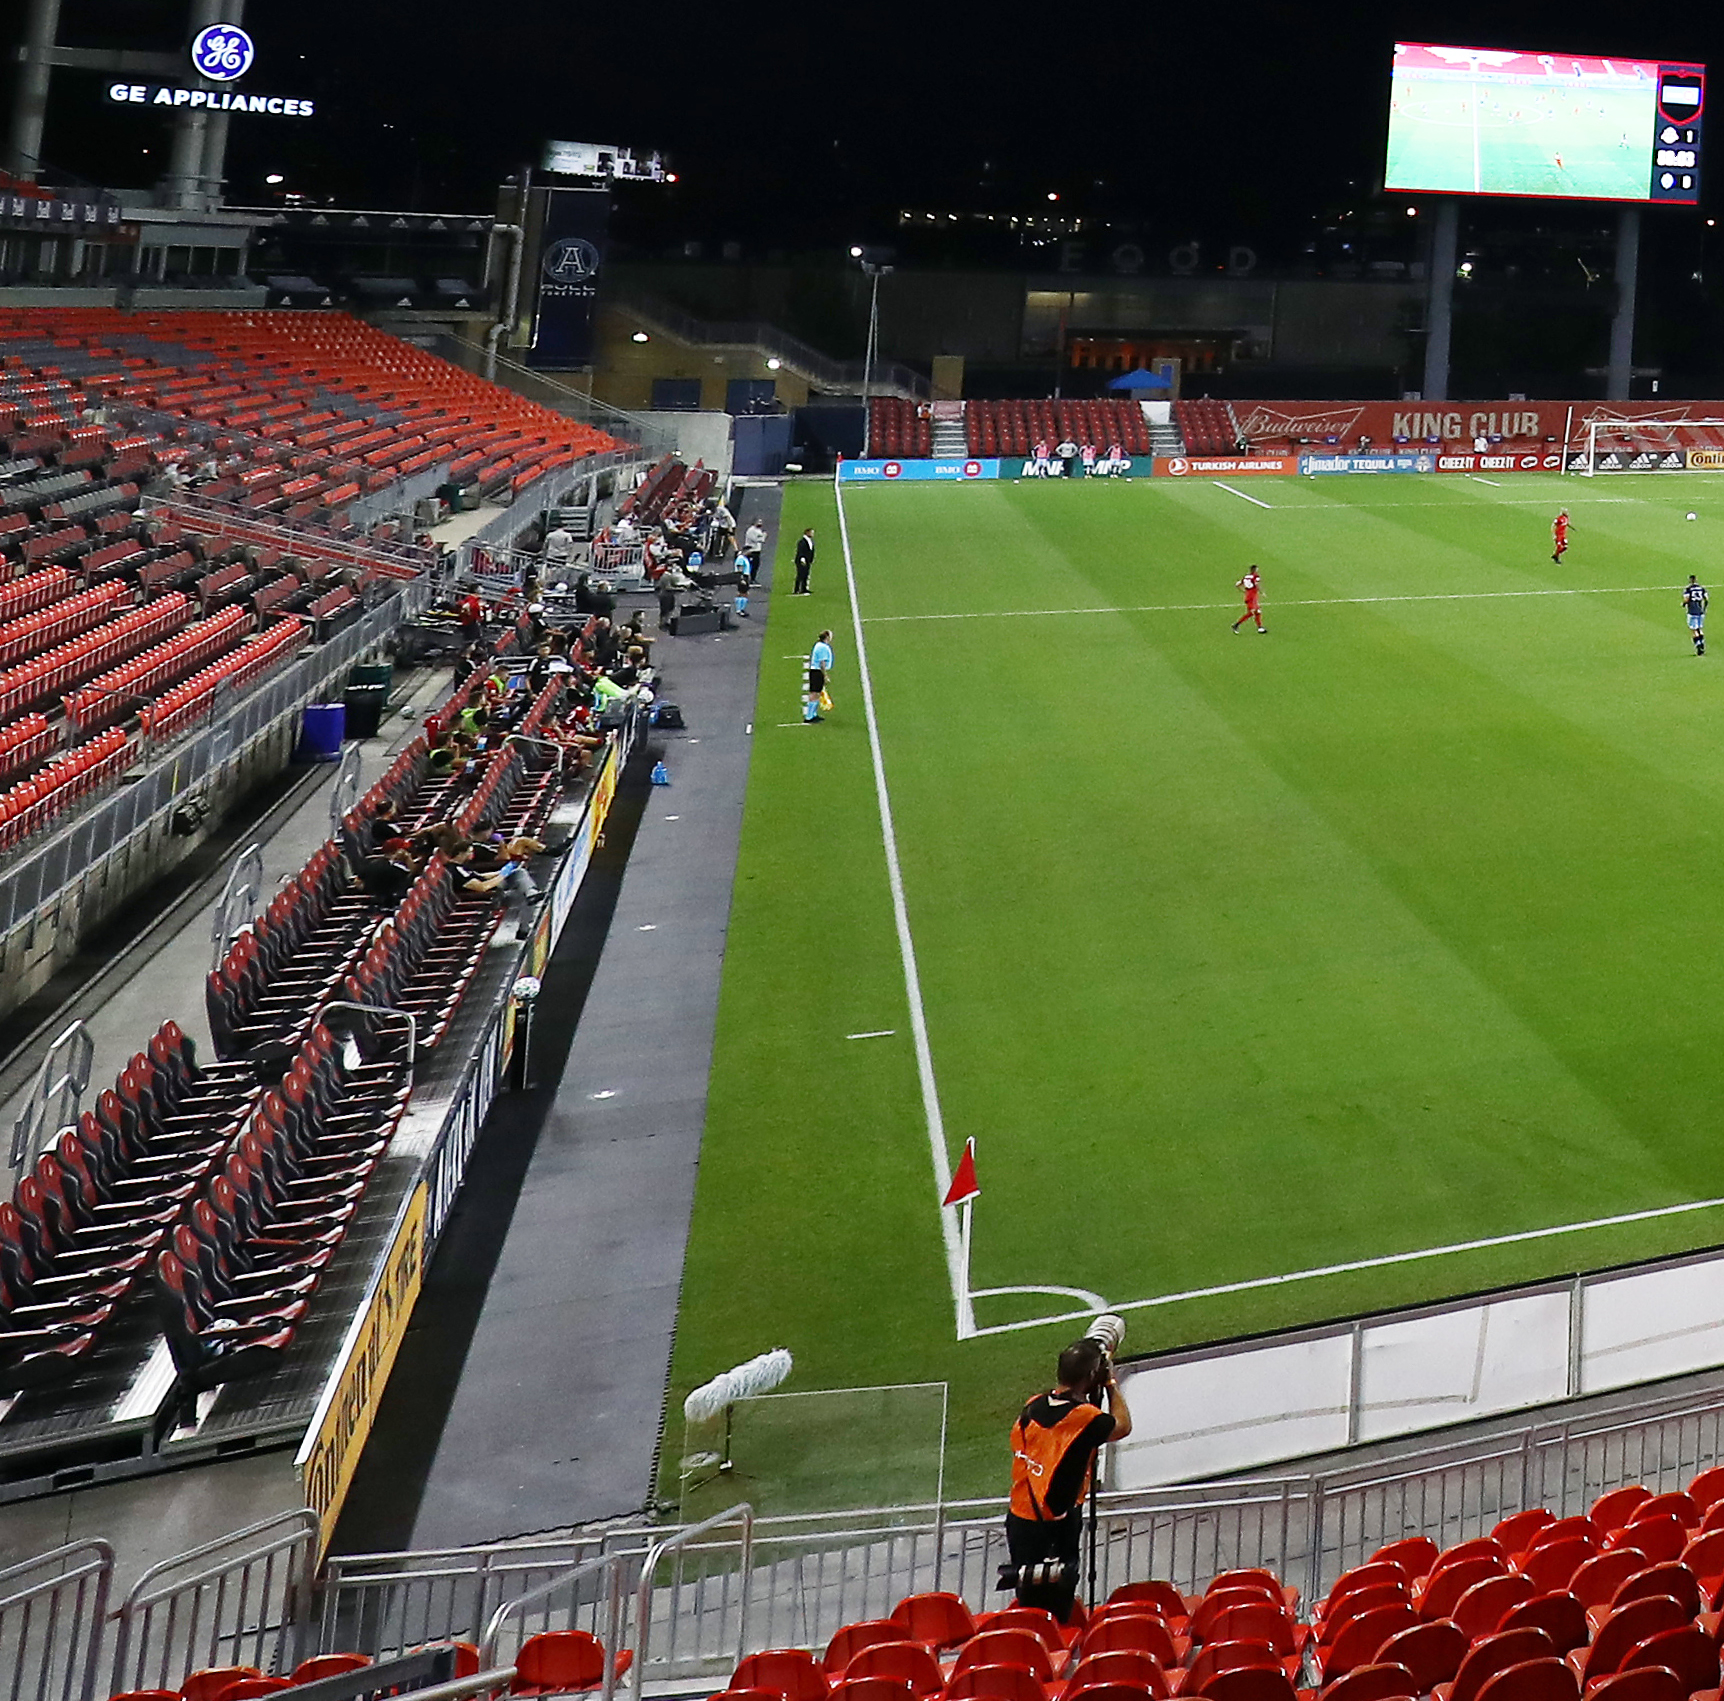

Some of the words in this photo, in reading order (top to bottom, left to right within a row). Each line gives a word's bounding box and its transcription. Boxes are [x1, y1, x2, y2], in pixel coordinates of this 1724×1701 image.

[109, 83, 148, 102] GE
[153, 87, 314, 117] APPLIANCES
[1240, 414, 1356, 436] Budweiser
[1392, 412, 1462, 439] KING
[1469, 412, 1539, 439] CLUB
[854, 466, 879, 475] BMO
[935, 465, 960, 474] BMO
[1191, 462, 1236, 471] TURKISH
[1237, 461, 1283, 470] AIRLINES
[1303, 455, 1351, 475] Jimador
[1352, 459, 1395, 470] TEQUILA
